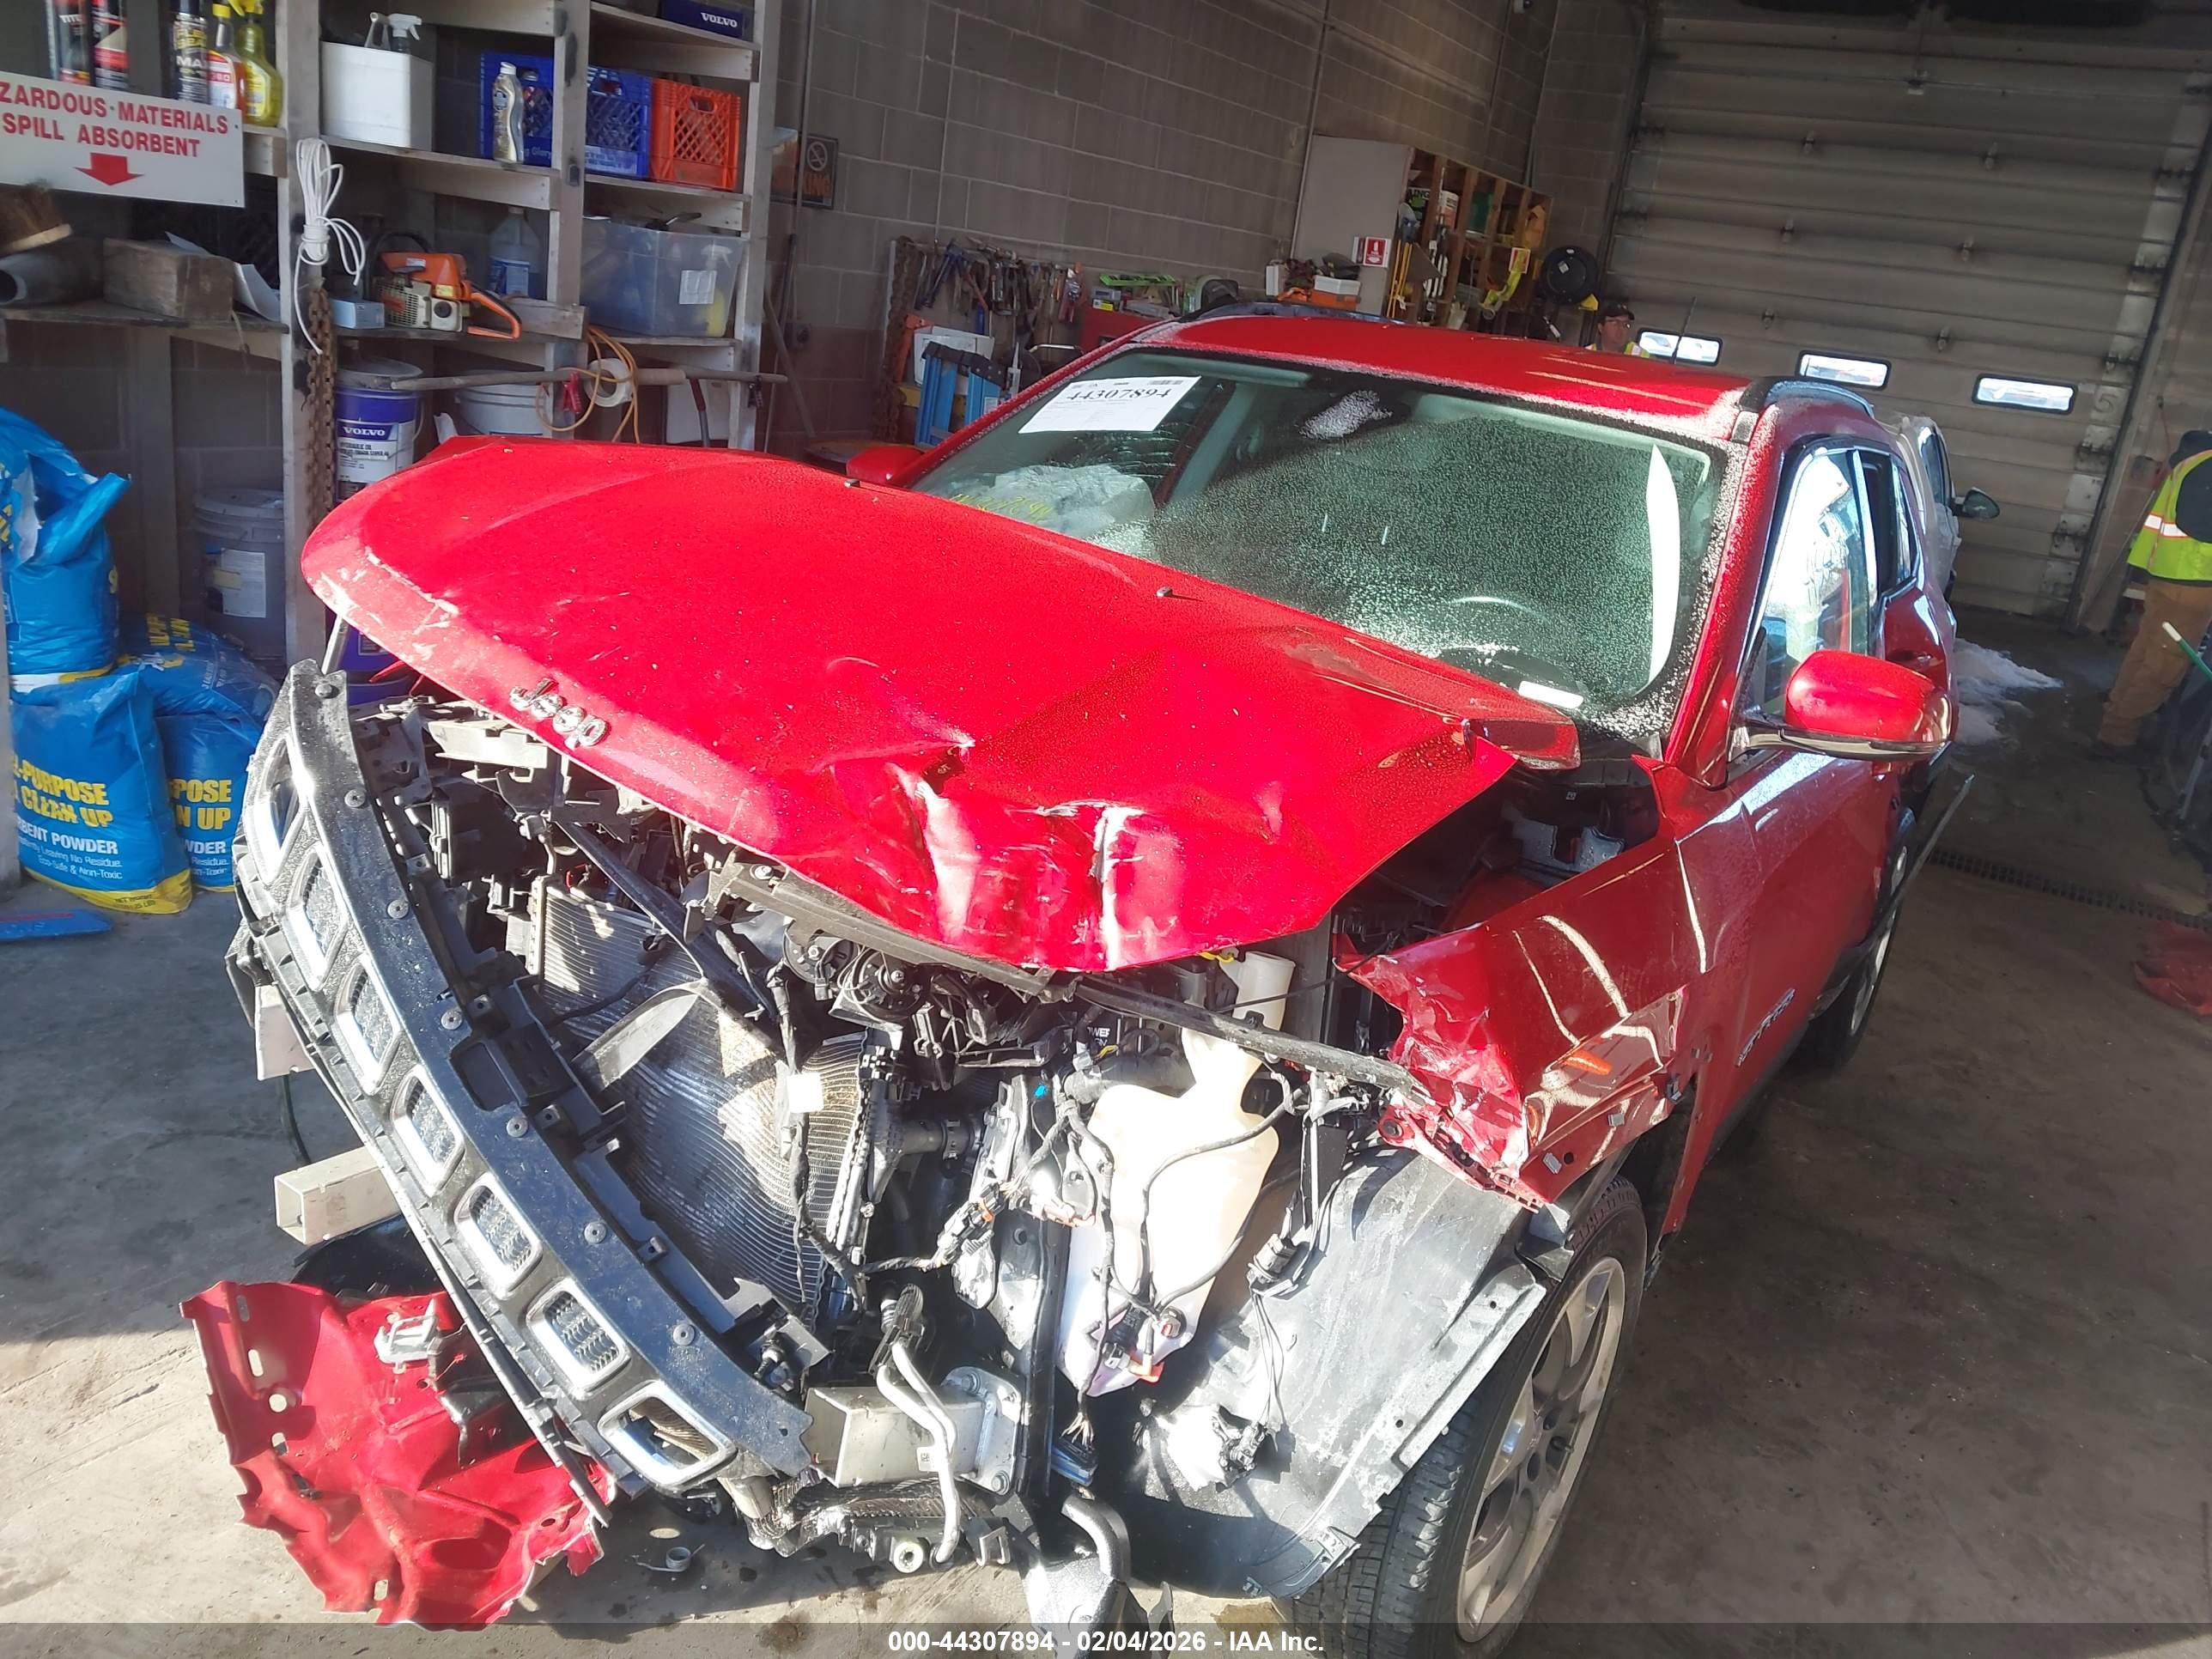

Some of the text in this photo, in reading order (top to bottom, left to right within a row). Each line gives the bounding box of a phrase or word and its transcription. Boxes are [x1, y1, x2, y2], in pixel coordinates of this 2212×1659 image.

[701, 12, 738, 27] VOLVO
[118, 100, 228, 134] MATERIALS
[3, 112, 200, 157] SPILL ABSORBENT
[1066, 388, 1172, 400] 44307894
[343, 427, 386, 436] VOLVO
[509, 677, 611, 750] Jeep
[21, 785, 79, 823] CLEAN
[79, 806, 113, 827] UP
[198, 807, 231, 830] UP
[52, 832, 118, 854] POWDER
[70, 854, 83, 864] No
[70, 865, 78, 875] &
[79, 867, 123, 879] Non-Toxic
